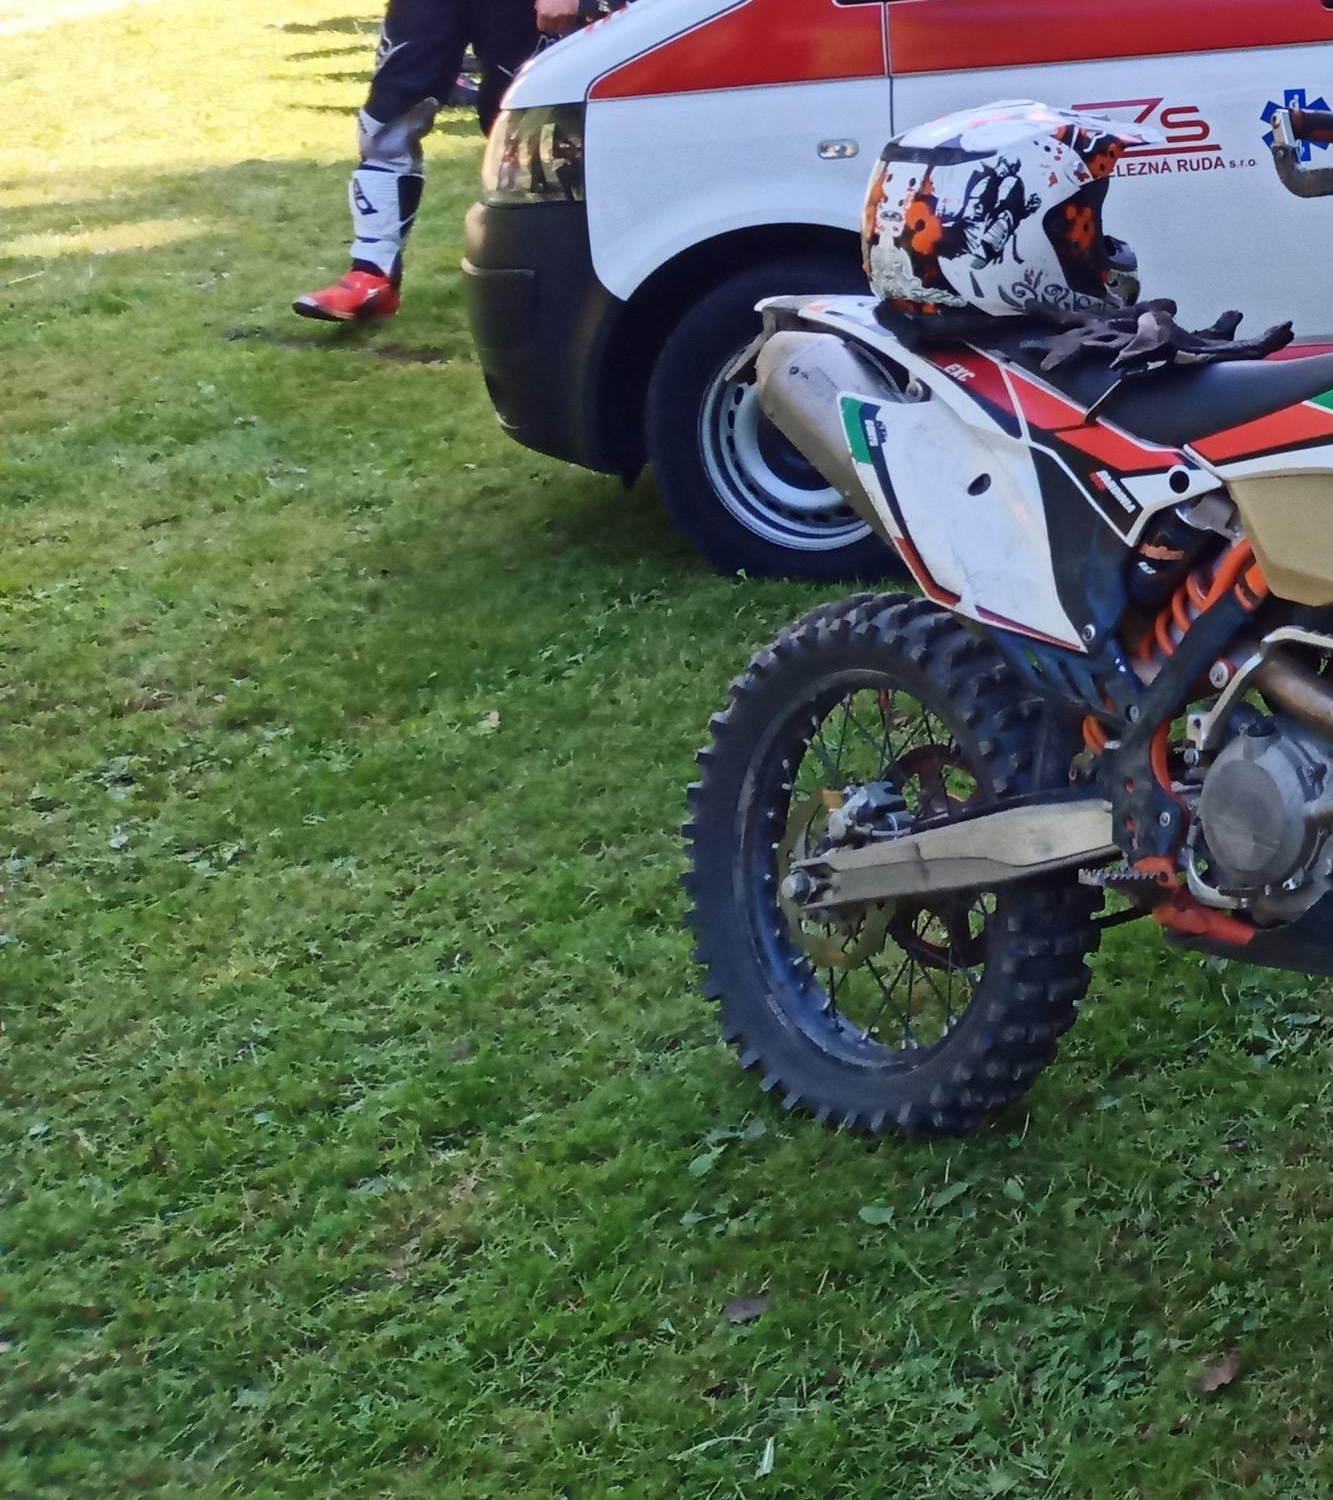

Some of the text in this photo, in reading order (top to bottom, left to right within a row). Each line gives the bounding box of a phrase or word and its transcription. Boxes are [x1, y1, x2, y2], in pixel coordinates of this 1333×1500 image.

[1109, 158, 1173, 178] LEZNÁ
[1177, 155, 1226, 173] RUDA
[943, 363, 976, 382] EXC
